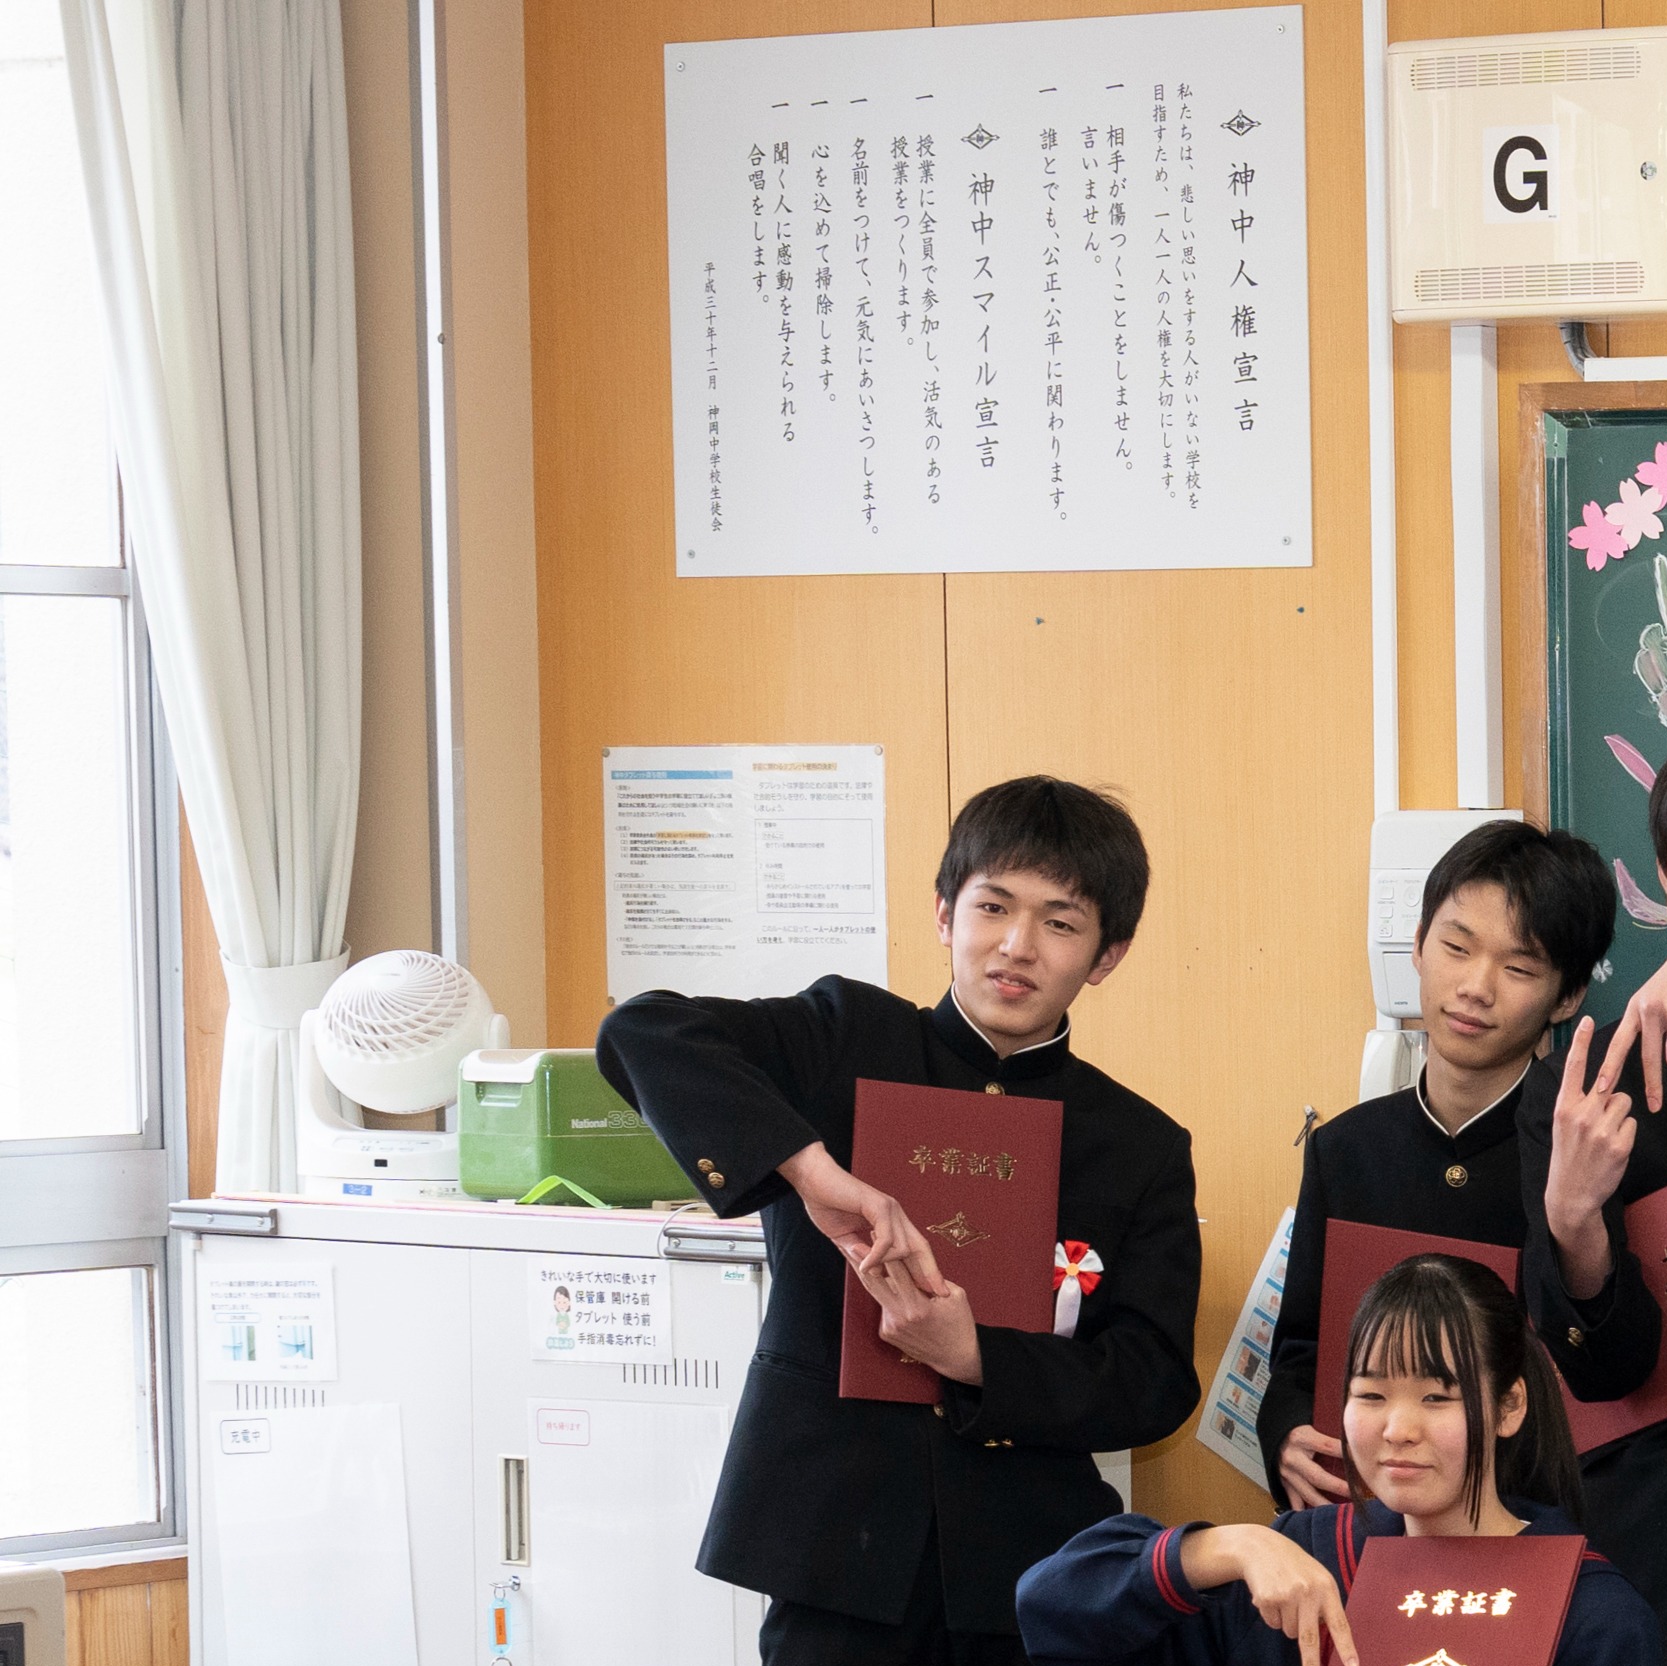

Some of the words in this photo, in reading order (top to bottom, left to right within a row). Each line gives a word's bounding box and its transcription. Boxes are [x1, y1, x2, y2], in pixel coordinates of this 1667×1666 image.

[747, 143, 770, 303] 合唱をします。
[890, 136, 915, 346] 授業をつくります。
[1080, 126, 1103, 265] 言いません。
[1492, 135, 1549, 214] G
[703, 262, 719, 391] 平成三十年十二月
[772, 142, 797, 443] 聞く人に感動を与えられる
[811, 143, 837, 403] 心を込めて掃除します。
[850, 137, 880, 535] 名前をつけて、元気にあいさつします。
[916, 133, 943, 505] 授業に全員で参加し、活気のある
[967, 172, 1000, 468] 神中スマイル宣言
[1040, 128, 1068, 521] 誰とでも、公正・公平に関わります。
[1106, 125, 1133, 471] 相手が傷つくことをしません。
[1152, 83, 1176, 499] 目指すため、一人一人の人権を大切にします。
[1177, 82, 1202, 510] 私たちは、悲しい思いをする人がいない学校を
[1227, 162, 1260, 432] 神中人権宣言
[707, 404, 724, 533] 神岡中学校生徒会
[571, 1118, 608, 1130] National
[908, 1145, 1018, 1181] 卒業証書
[540, 1269, 657, 1286] きれいな手で大切に使います
[575, 1290, 606, 1304] 保管庫
[611, 1292, 650, 1306] 開ける前
[575, 1311, 617, 1324] タブレット
[622, 1313, 651, 1327] 使う前
[724, 1271, 745, 1280] Active
[230, 1429, 261, 1444] 充電中
[1397, 1586, 1518, 1619] 卒業証書
